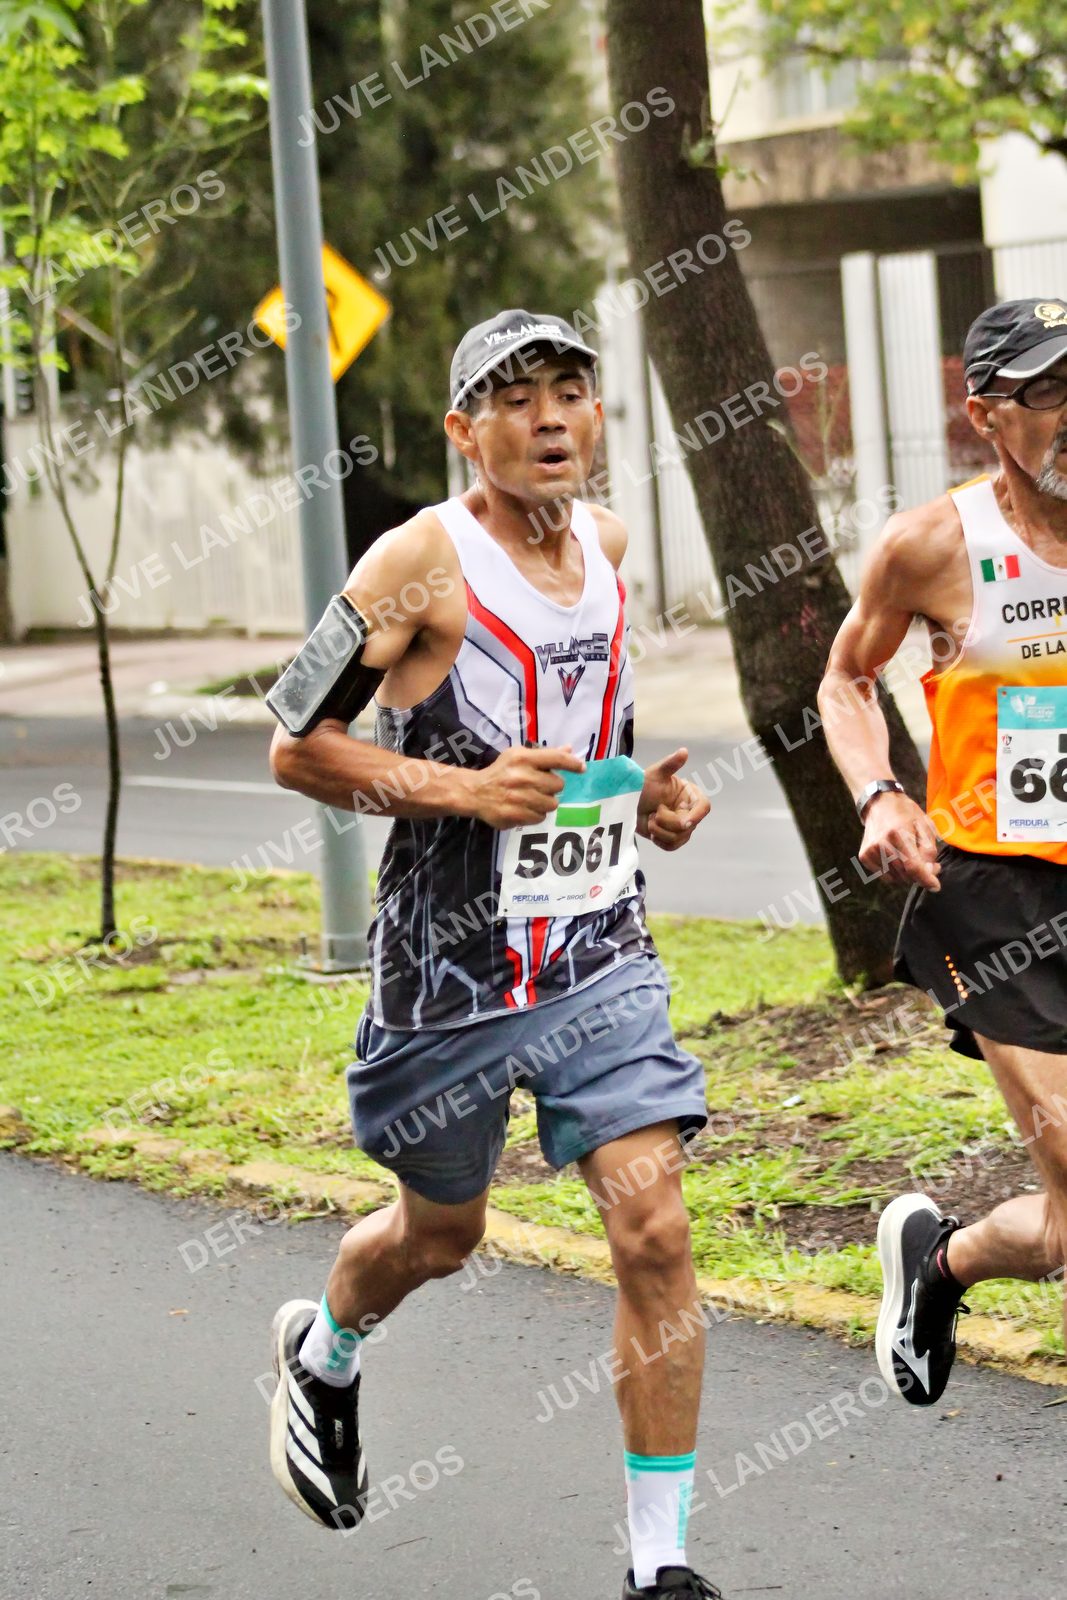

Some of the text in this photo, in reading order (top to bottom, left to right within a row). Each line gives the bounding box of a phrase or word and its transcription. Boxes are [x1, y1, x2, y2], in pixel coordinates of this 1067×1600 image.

[1021, 640, 1066, 659] DE LA
[1009, 819, 1049, 827] PERDURA
[514, 822, 623, 879] 5061
[512, 894, 550, 902] PERDURA
